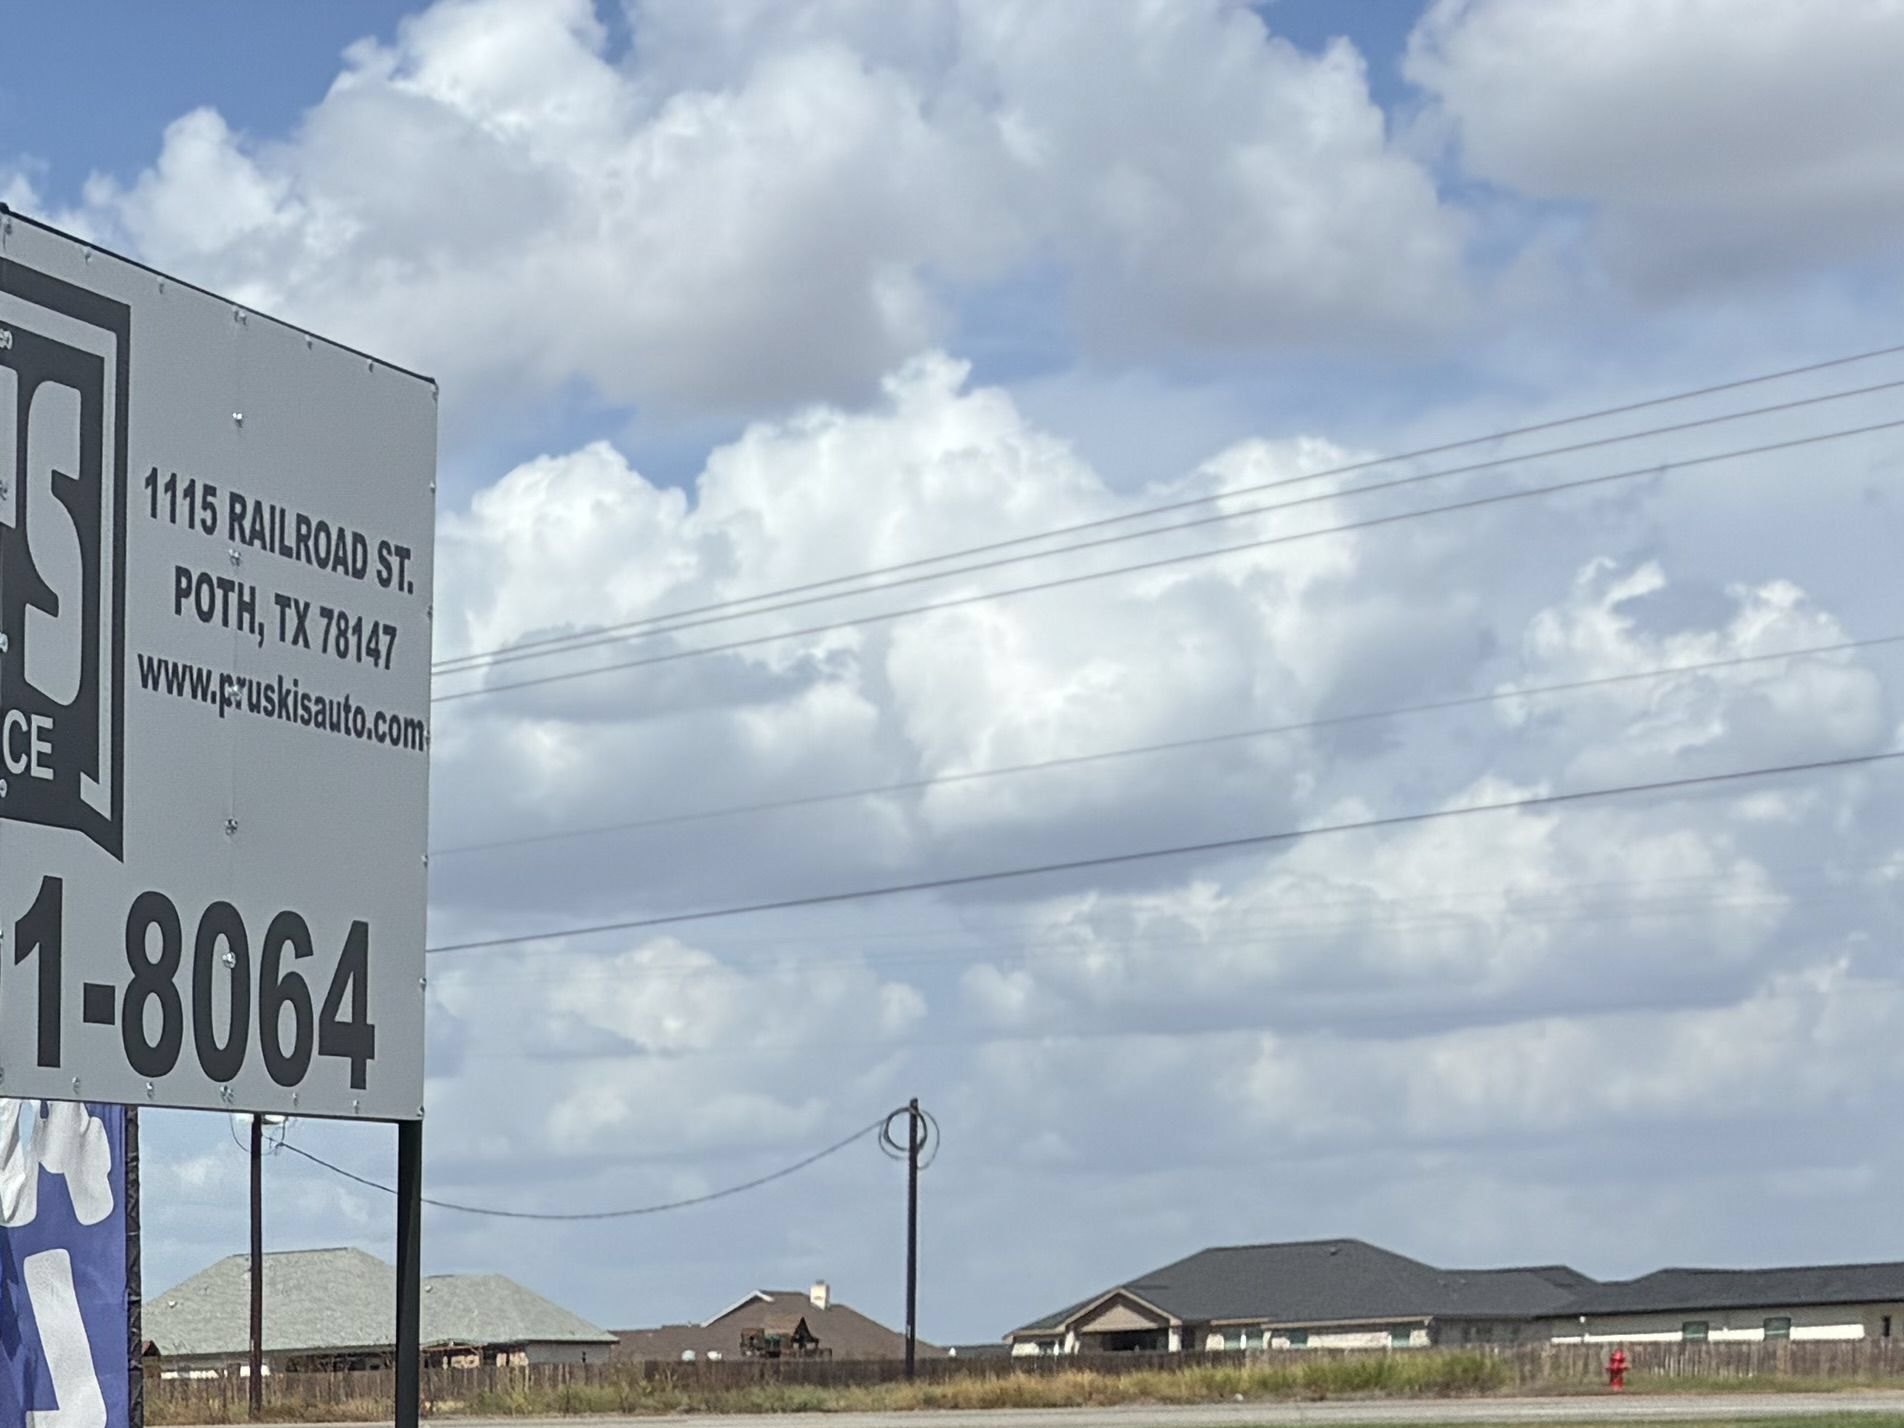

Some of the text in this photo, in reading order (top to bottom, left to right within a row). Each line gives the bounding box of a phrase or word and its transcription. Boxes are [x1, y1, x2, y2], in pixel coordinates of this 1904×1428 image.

[144, 466, 415, 595] 1115 RAILROAD ST.
[174, 564, 398, 671] POTH, TX 78147
[137, 652, 425, 753] www.pruskisauto.com
